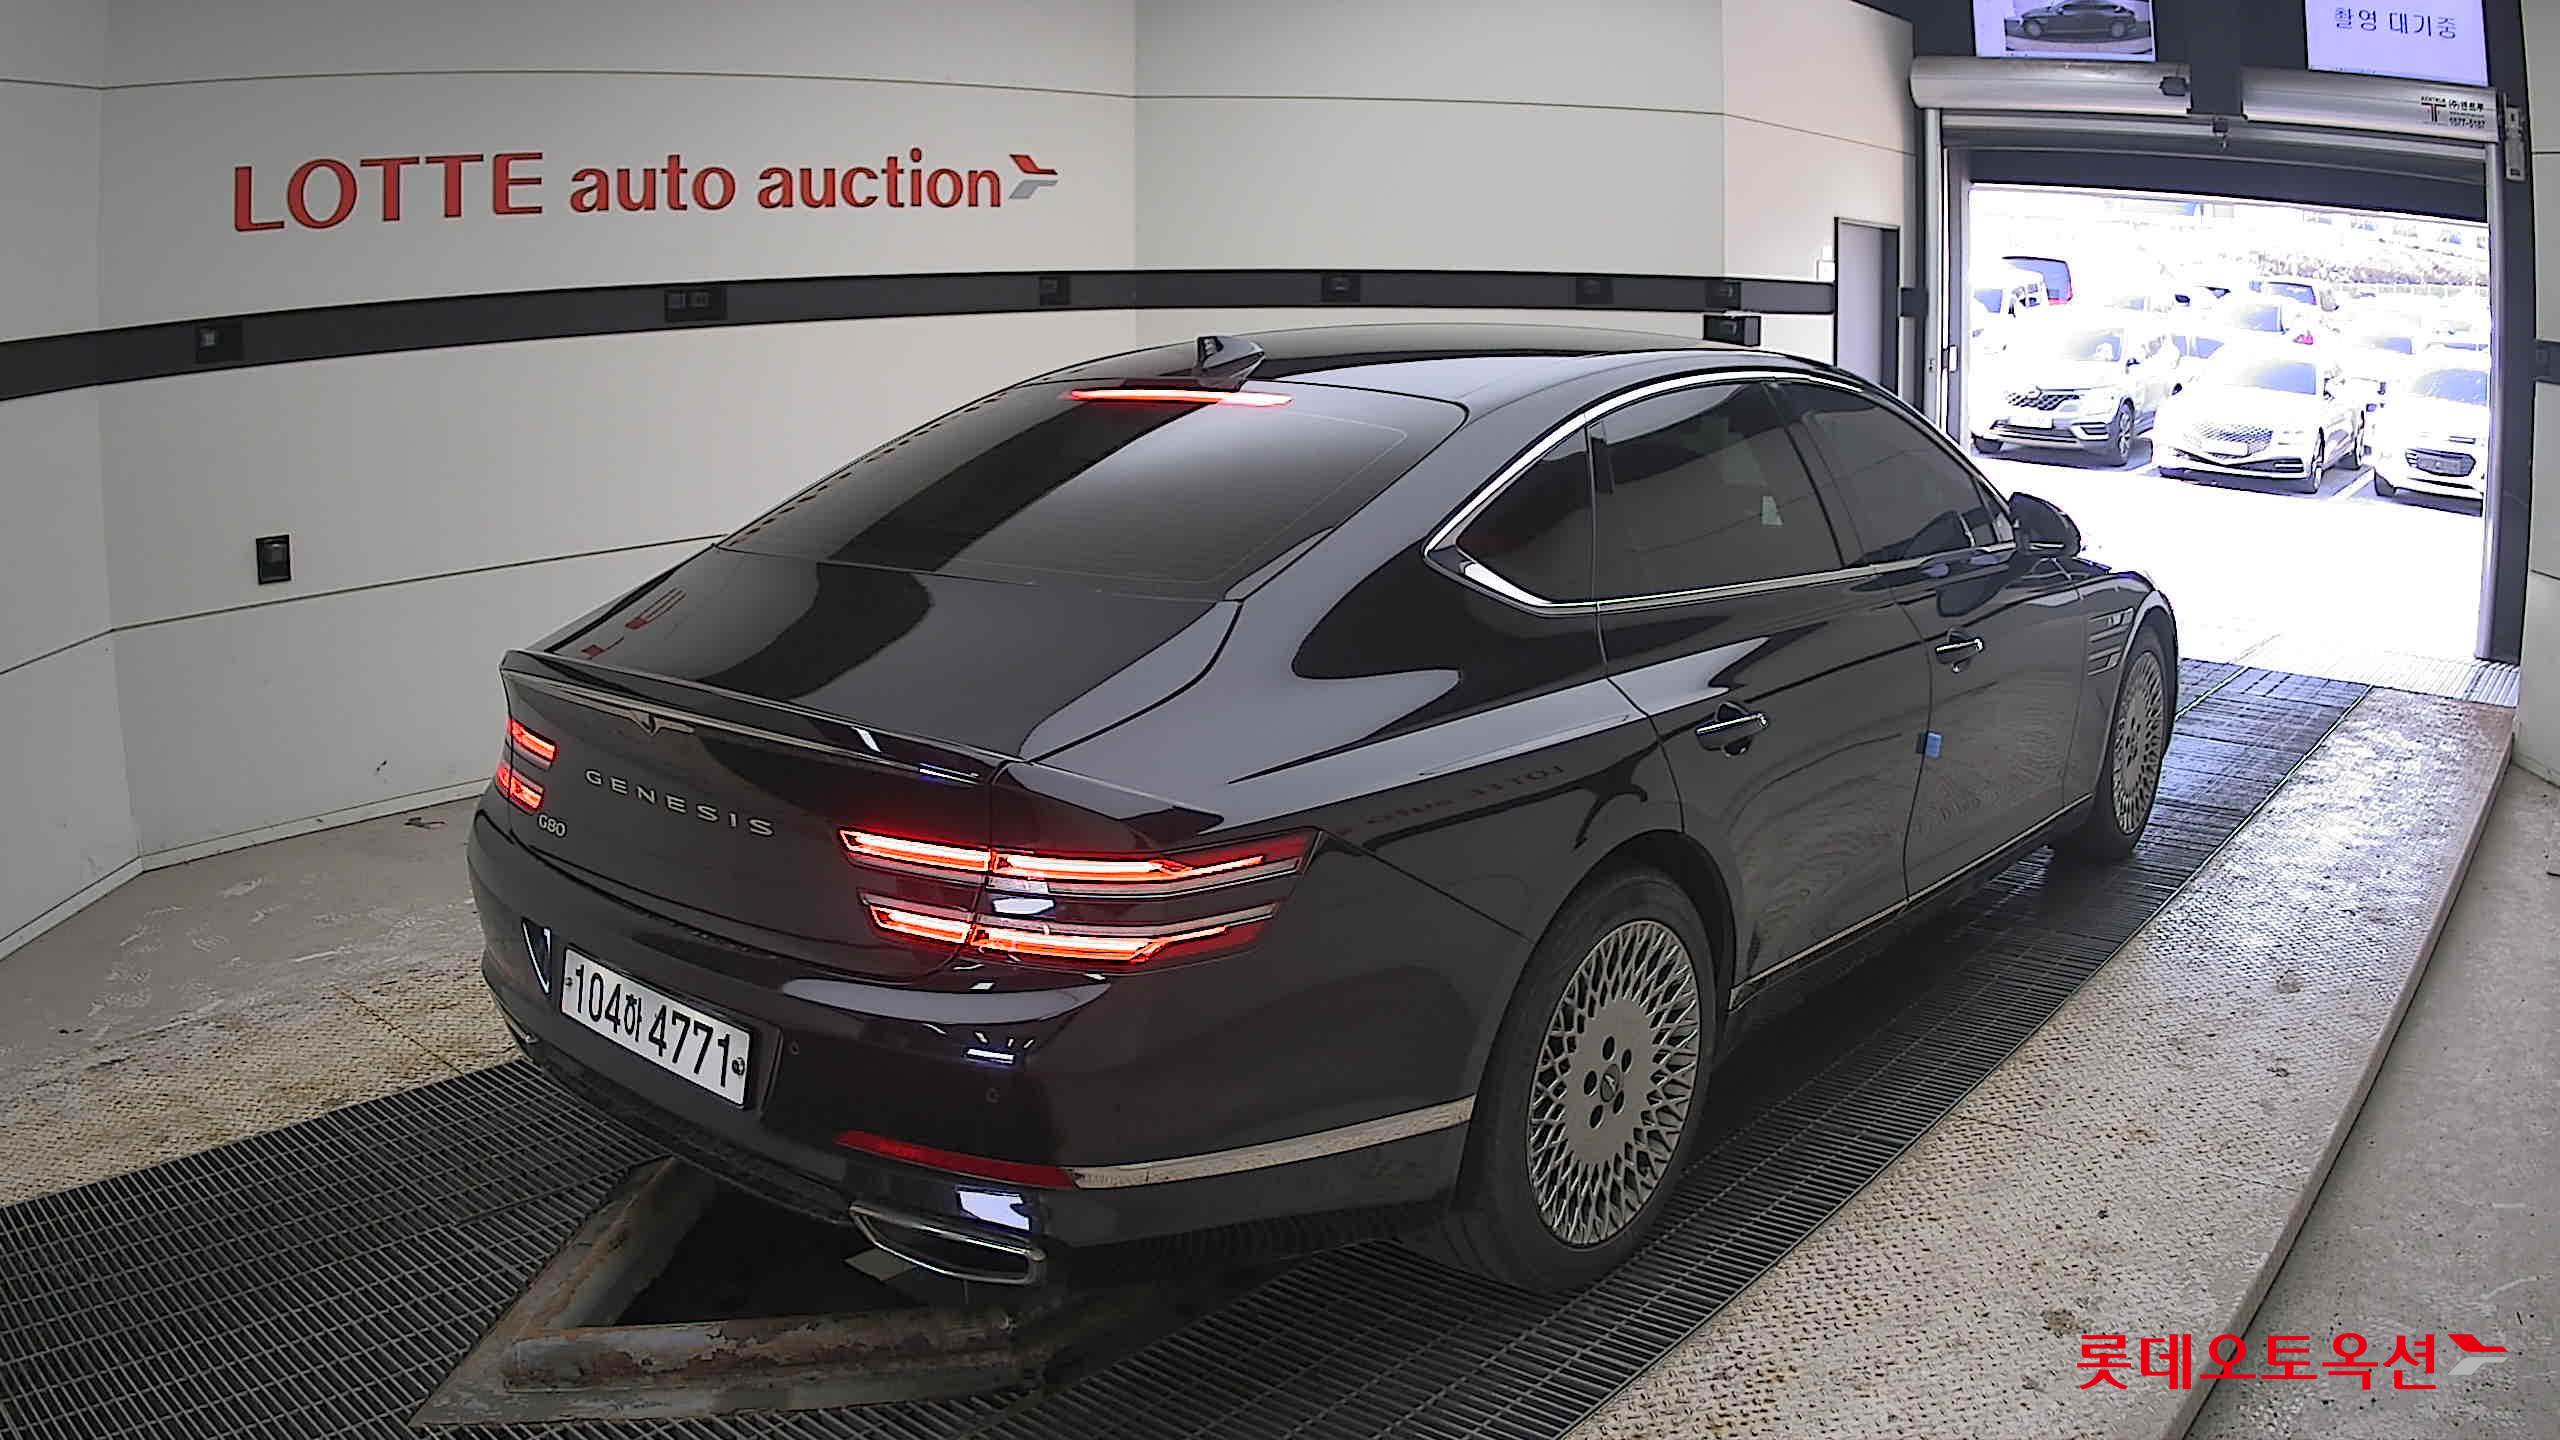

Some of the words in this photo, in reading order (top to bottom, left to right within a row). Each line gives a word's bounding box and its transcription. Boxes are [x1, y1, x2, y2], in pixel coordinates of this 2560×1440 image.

[2335, 7, 2377, 31] 촬영
[2389, 12, 2456, 40] 대기중
[234, 151, 544, 233] LOTTE
[569, 152, 737, 214] auto
[757, 147, 1002, 211] auction
[537, 813, 567, 838] G80
[584, 768, 776, 837] GENESIS
[575, 963, 643, 1043] 104하
[648, 1003, 731, 1088] 4771
